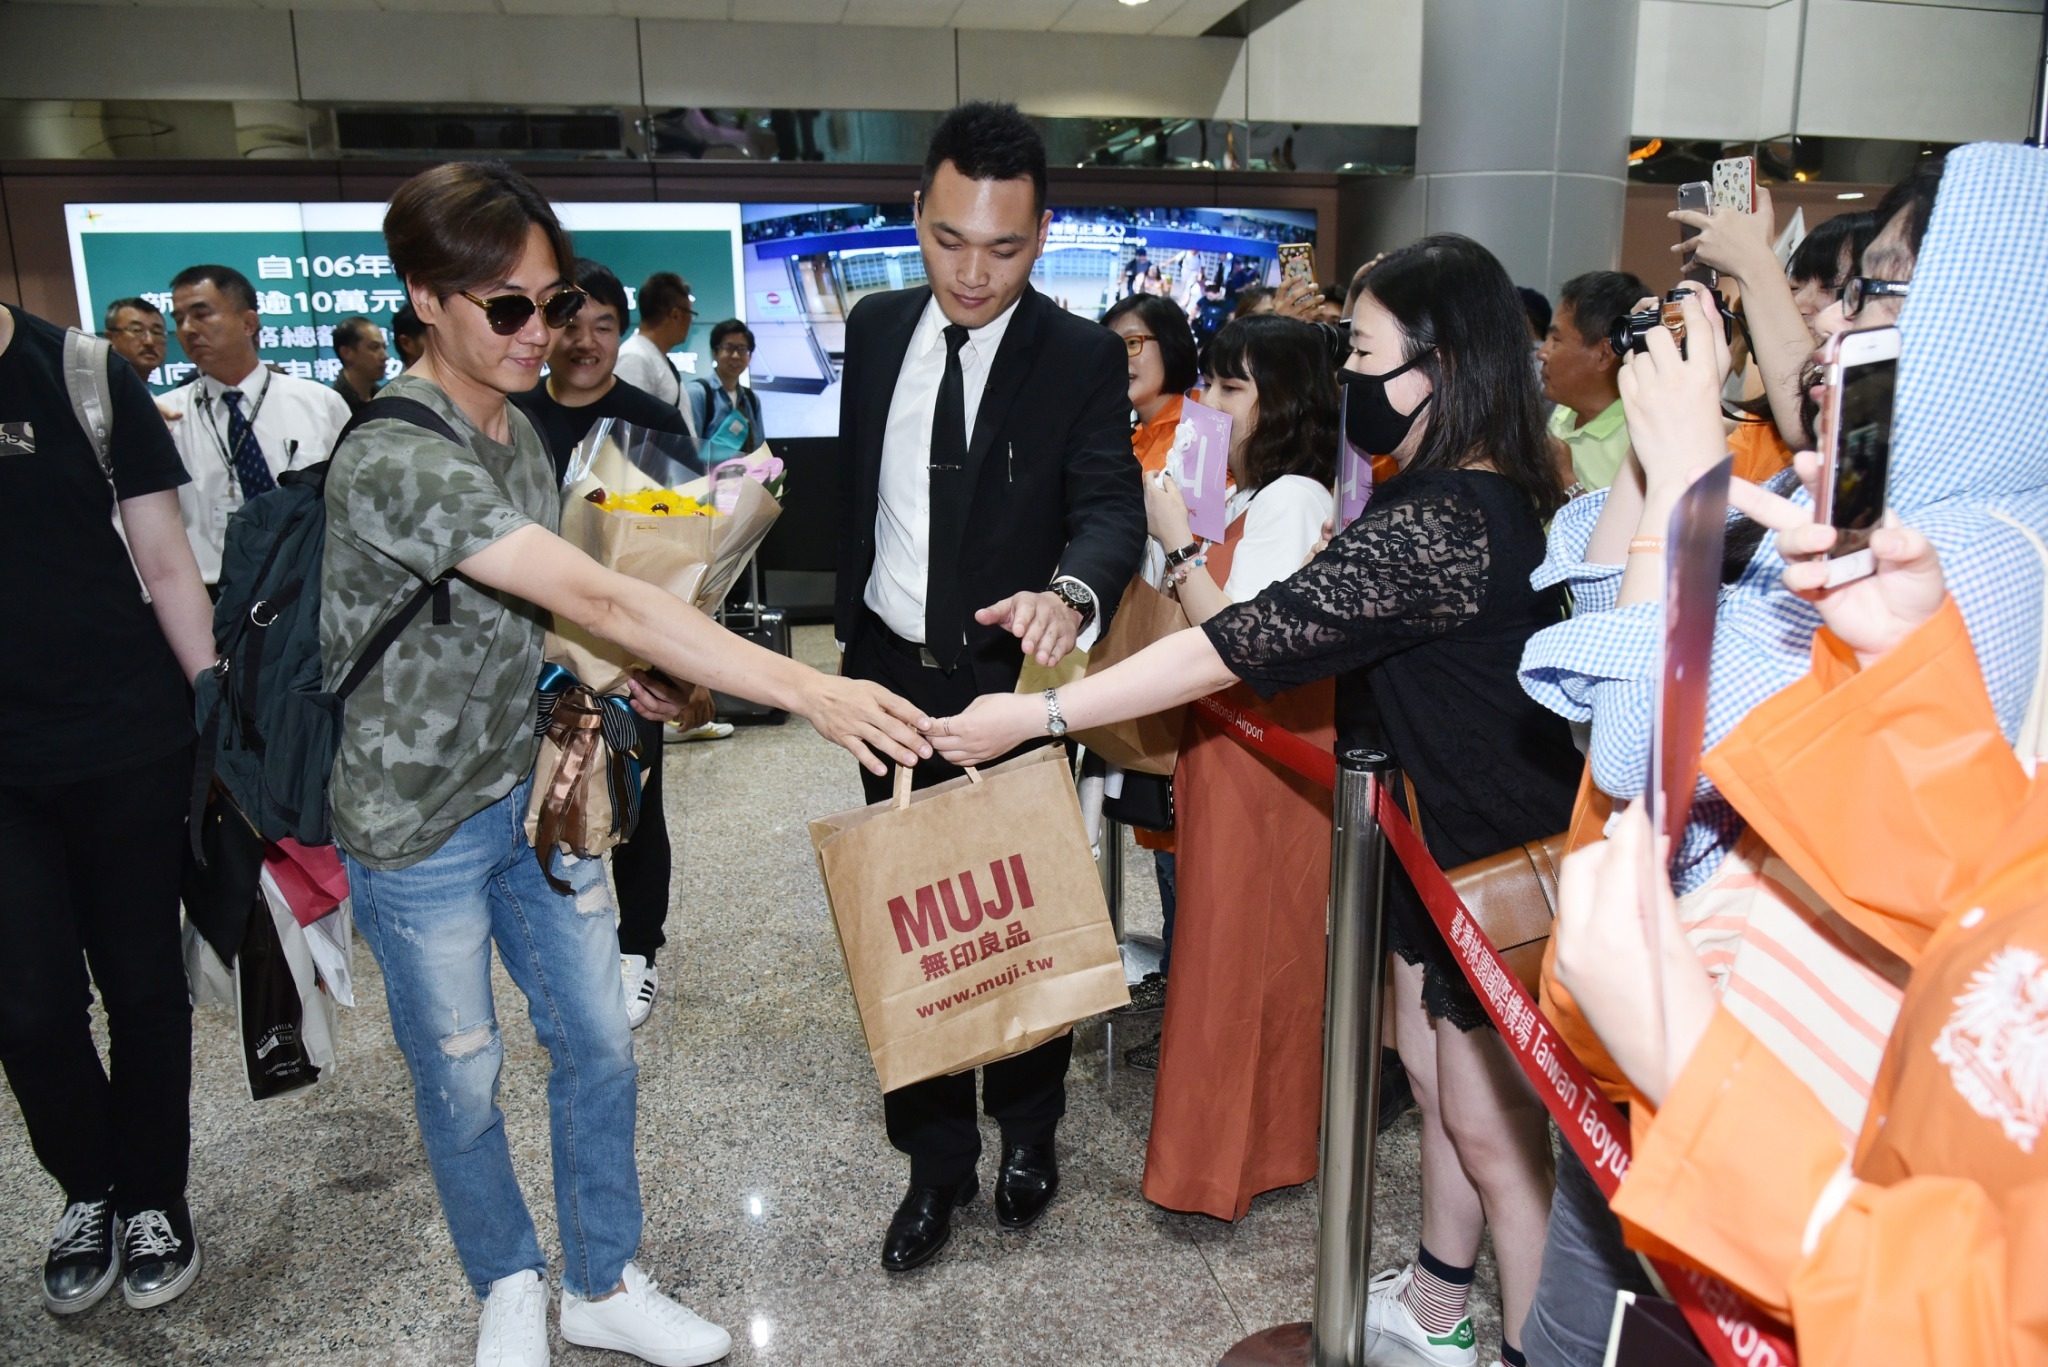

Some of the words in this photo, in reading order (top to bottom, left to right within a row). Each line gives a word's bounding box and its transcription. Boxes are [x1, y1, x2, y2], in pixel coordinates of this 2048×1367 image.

[1235, 712, 1264, 742] Airport
[887, 853, 1035, 955] MUJI
[919, 920, 1031, 982] 無印良品
[915, 956, 1054, 1019] www.muji.tw
[1449, 907, 1537, 1051] 臺灣桃園國際機場
[1532, 1023, 1579, 1110] Taiwan
